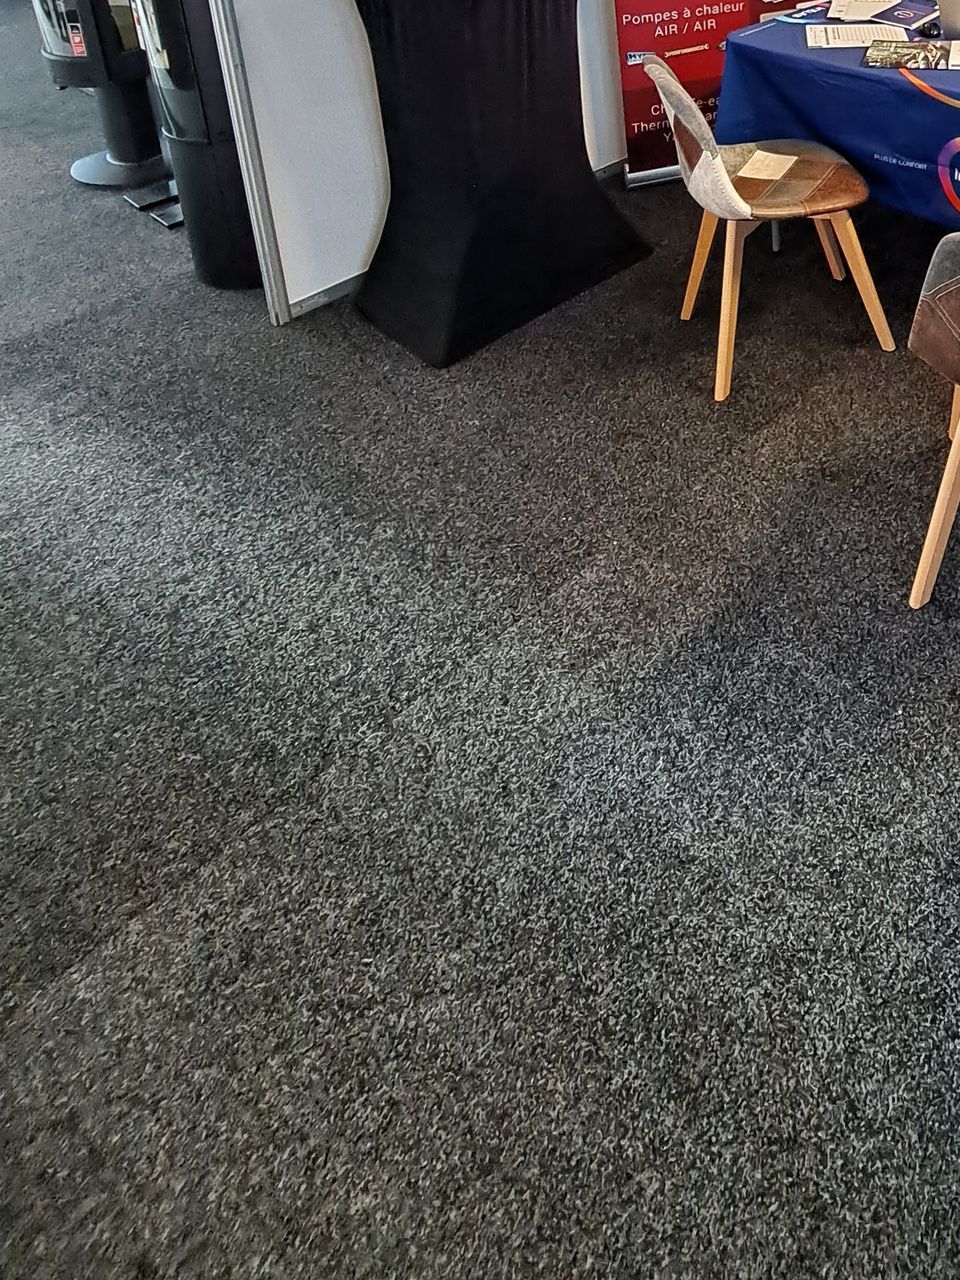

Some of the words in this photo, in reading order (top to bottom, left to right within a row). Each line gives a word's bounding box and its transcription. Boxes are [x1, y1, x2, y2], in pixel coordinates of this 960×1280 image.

[622, 9, 678, 25] Pompes
[683, 7, 692, 18] à
[695, 2, 745, 16] chaleur
[654, 24, 678, 38] AIR
[693, 19, 716, 32] AIR
